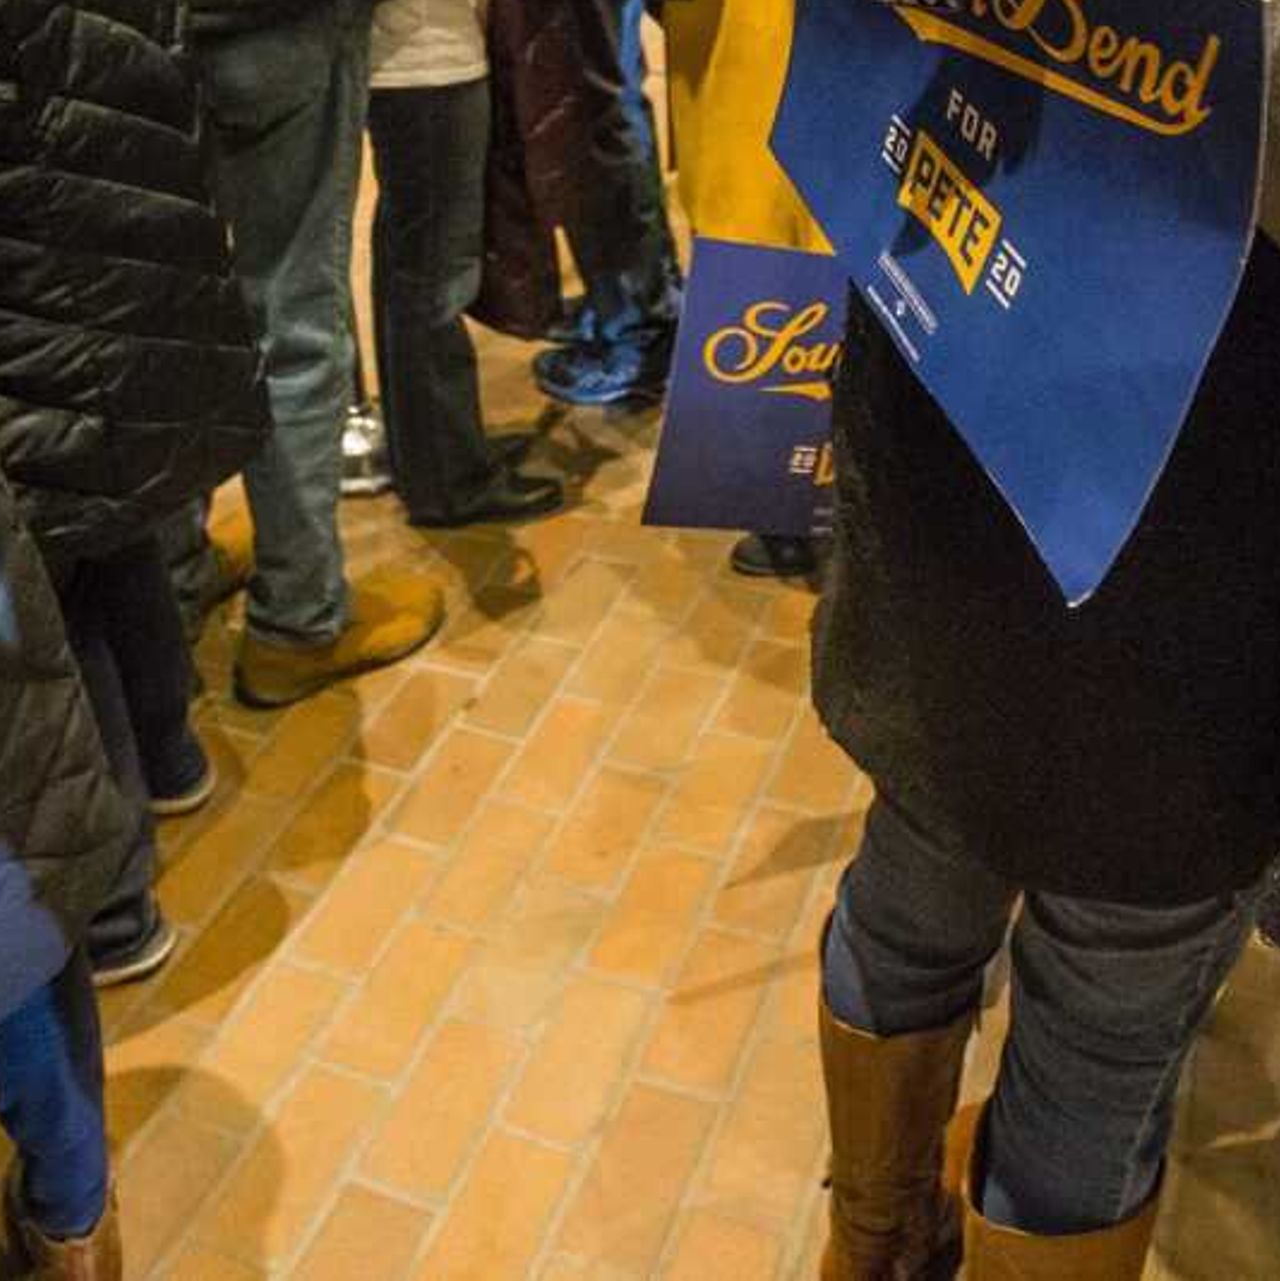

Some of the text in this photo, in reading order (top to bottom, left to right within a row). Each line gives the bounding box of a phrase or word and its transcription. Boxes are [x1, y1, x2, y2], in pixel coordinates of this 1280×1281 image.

[946, 88, 998, 161] FOR
[884, 125, 1022, 296] 20 PETE 20
